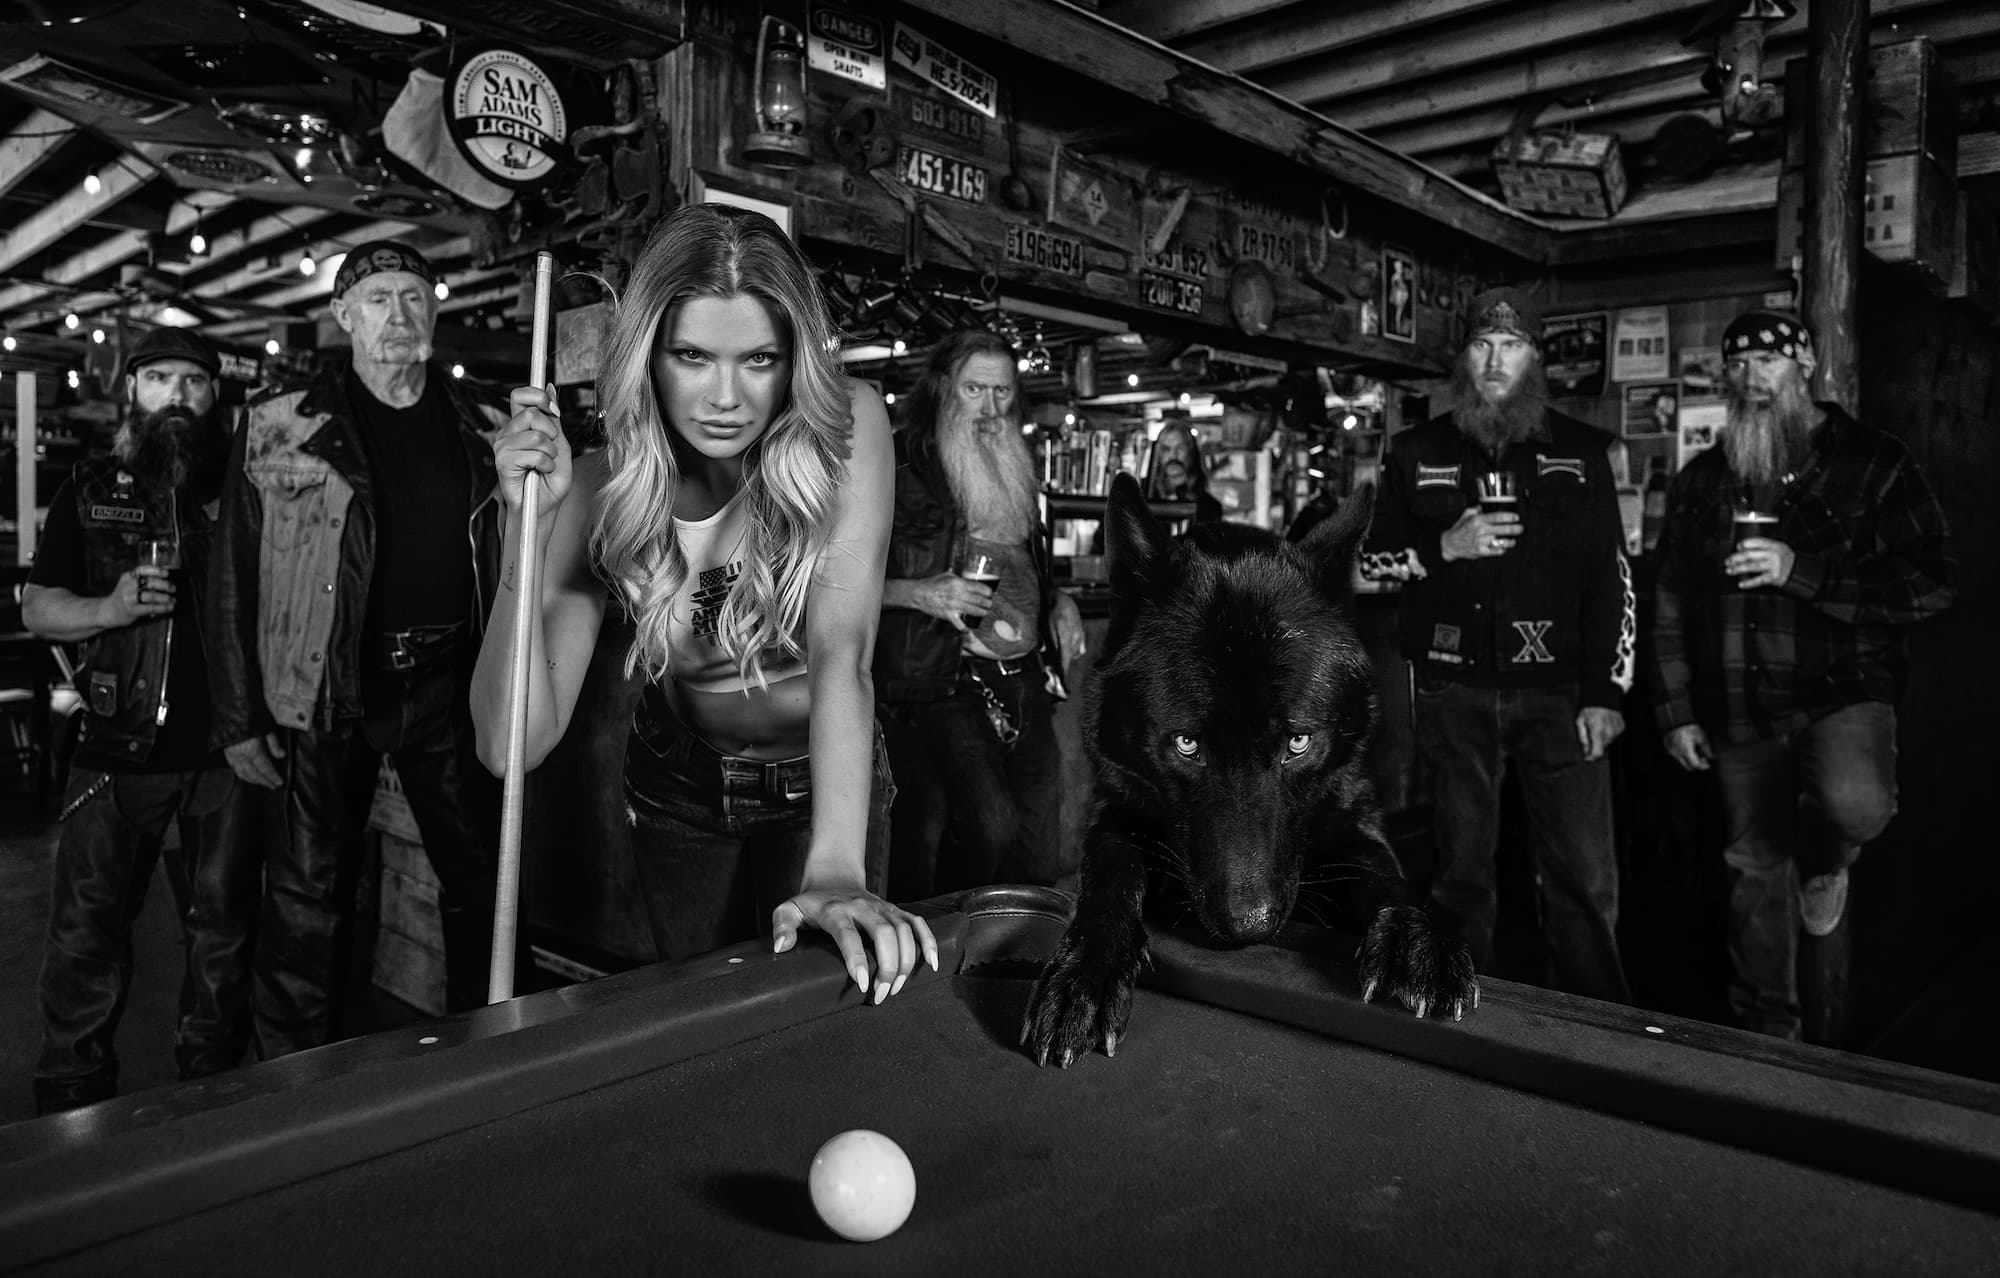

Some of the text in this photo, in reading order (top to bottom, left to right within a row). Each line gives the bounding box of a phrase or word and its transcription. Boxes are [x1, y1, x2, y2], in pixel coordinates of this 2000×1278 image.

[820, 12, 873, 44] DANGER
[823, 41, 847, 58] OPEN
[833, 59, 864, 78] SHAFTS
[484, 68, 538, 106] SAM
[479, 95, 543, 127] ADAMS
[475, 117, 542, 148] LIGHT
[1511, 620, 1555, 663] X
